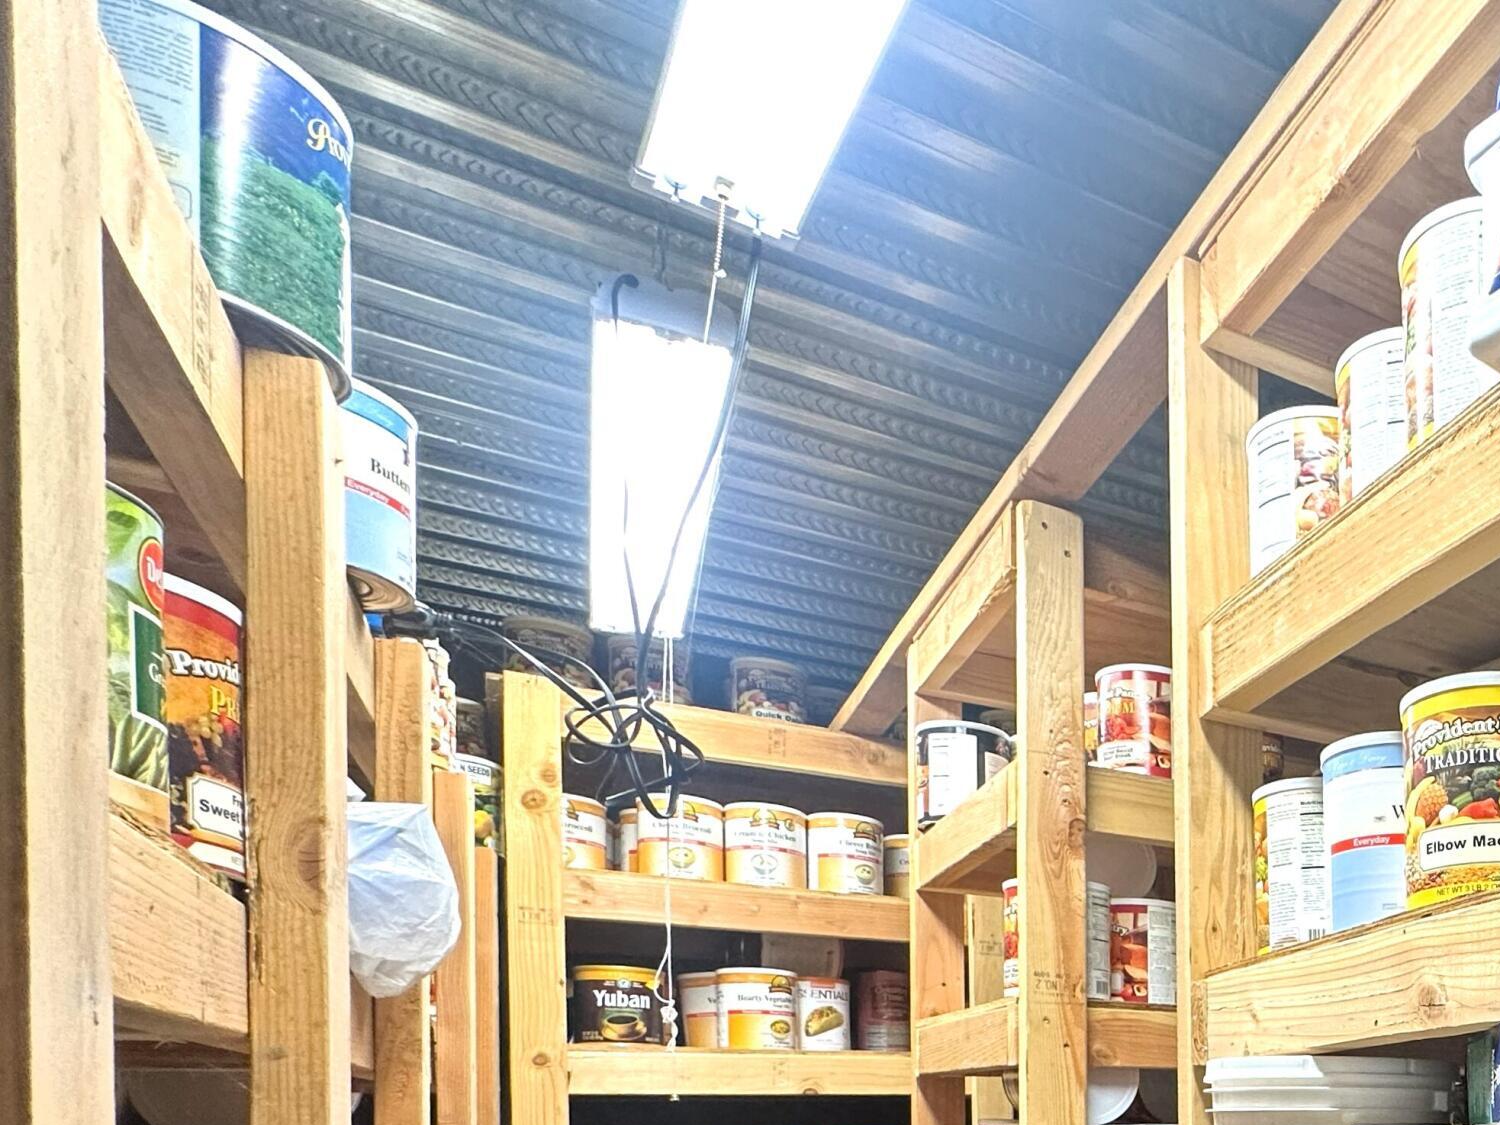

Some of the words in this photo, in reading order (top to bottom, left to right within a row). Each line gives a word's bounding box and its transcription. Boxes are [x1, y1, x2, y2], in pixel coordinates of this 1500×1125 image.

[755, 709, 782, 720] Quick
[1412, 717, 1495, 757] Provident
[199, 798, 240, 824] Sweet
[1353, 835, 1390, 848] Everyday
[1426, 837, 1466, 855] Elbow
[593, 989, 650, 1009] Yuban
